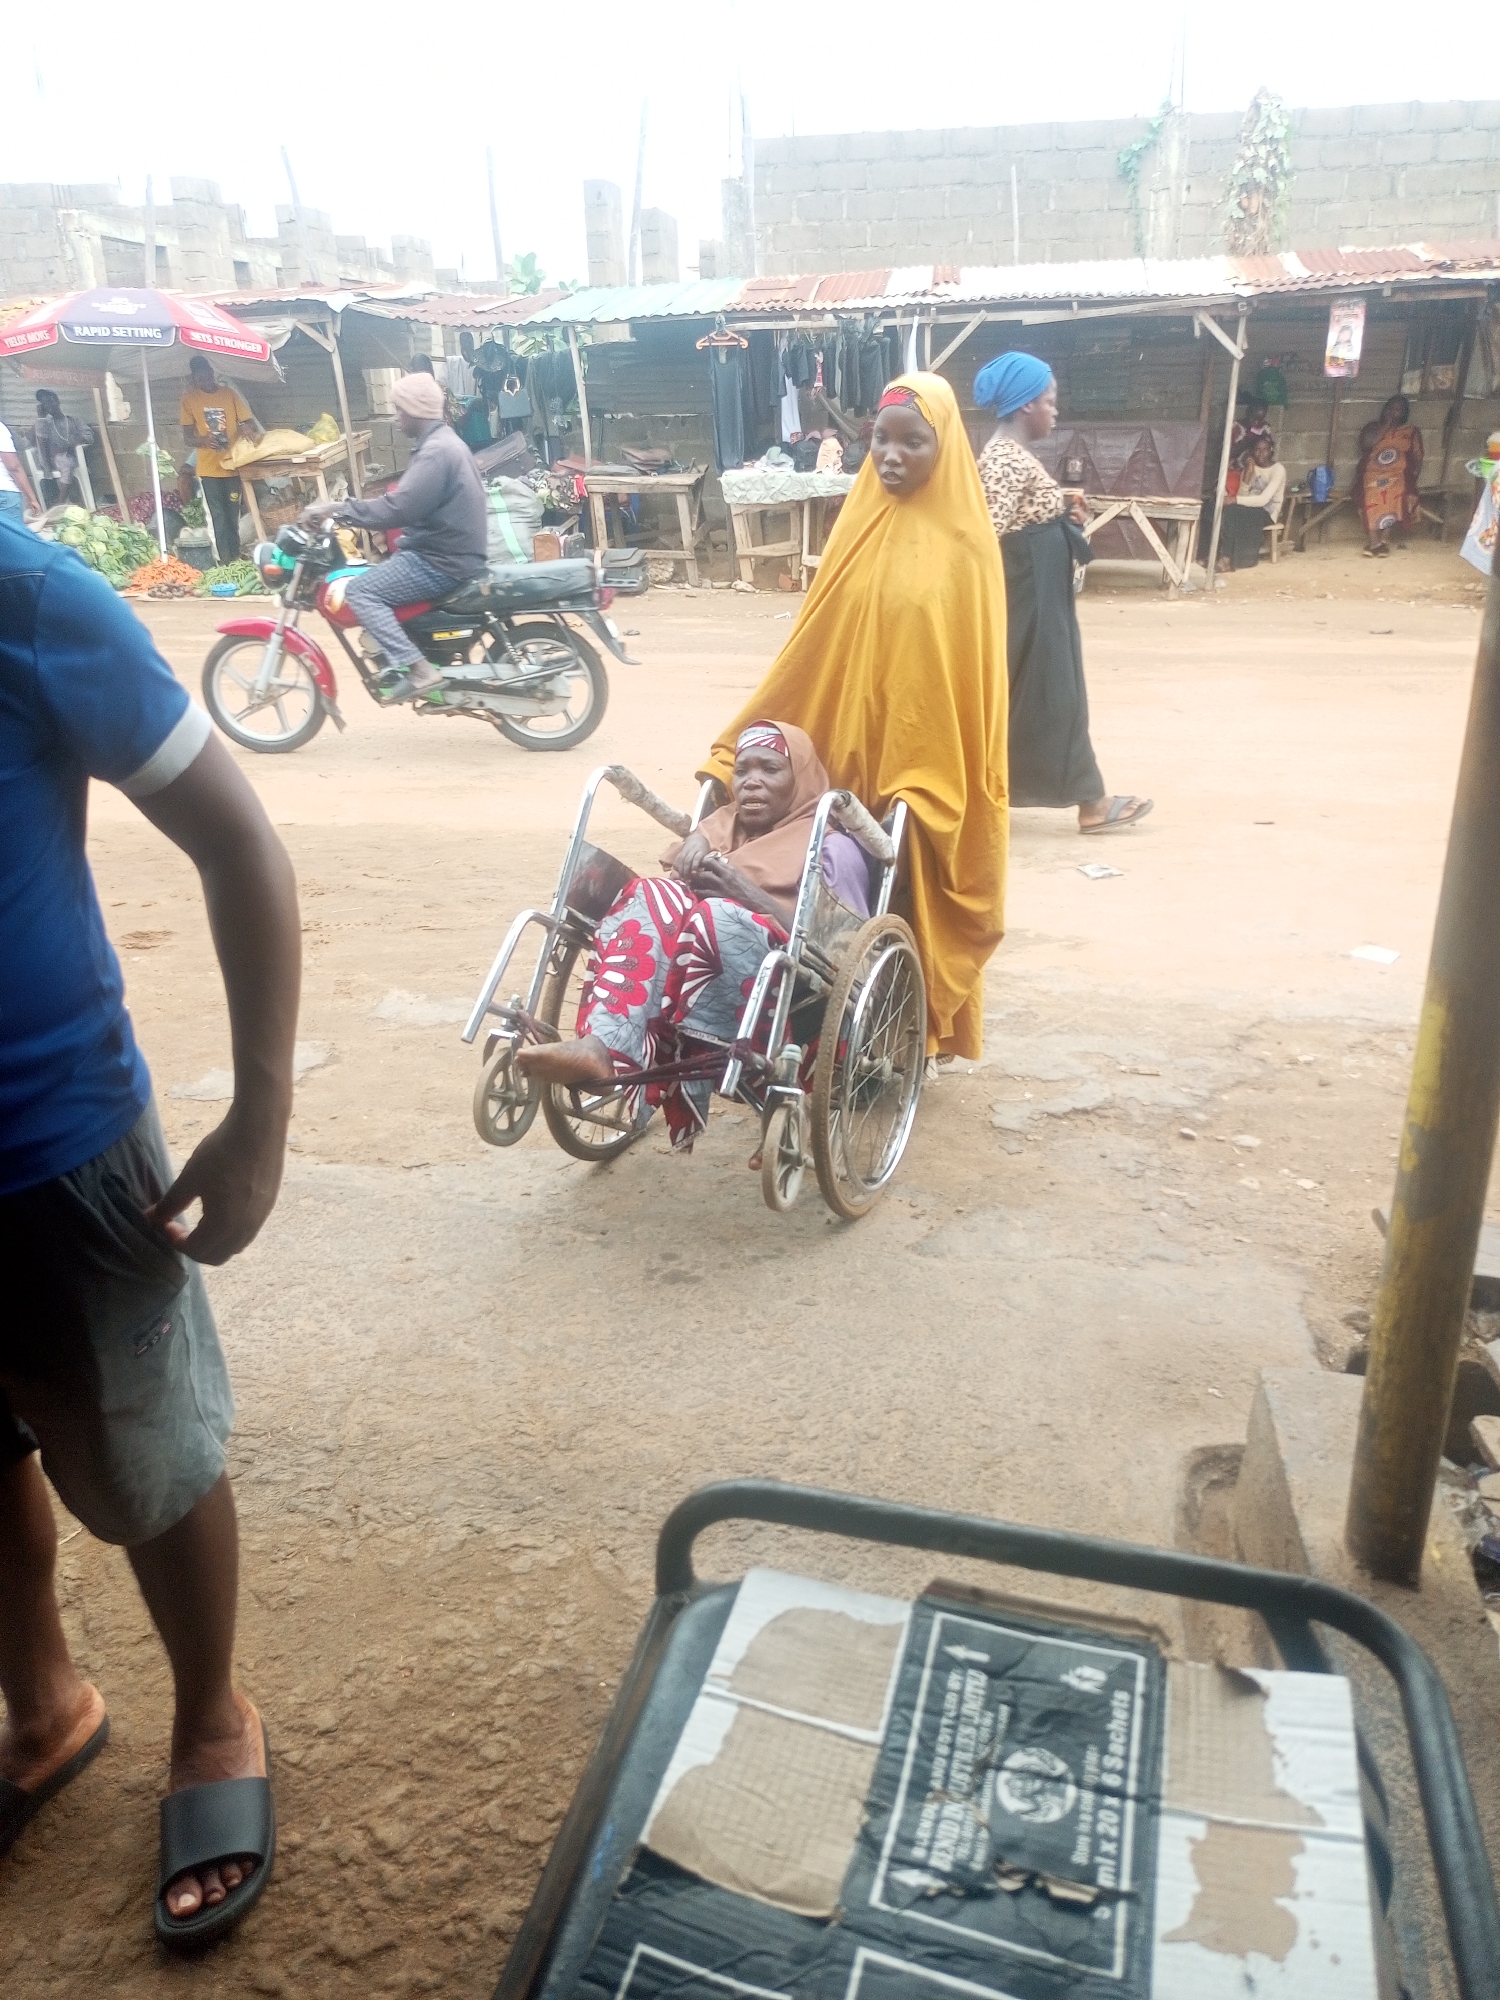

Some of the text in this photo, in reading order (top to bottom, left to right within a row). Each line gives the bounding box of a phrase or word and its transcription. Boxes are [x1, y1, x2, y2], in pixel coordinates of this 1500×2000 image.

[26, 328, 51, 344] MORE
[74, 325, 163, 340] RAPID SETTING
[190, 331, 264, 354] SETS STRONGER
[1102, 1689, 1132, 1771] Sachets
[930, 1755, 948, 1790] AND
[1096, 1808, 1120, 1839] 20
